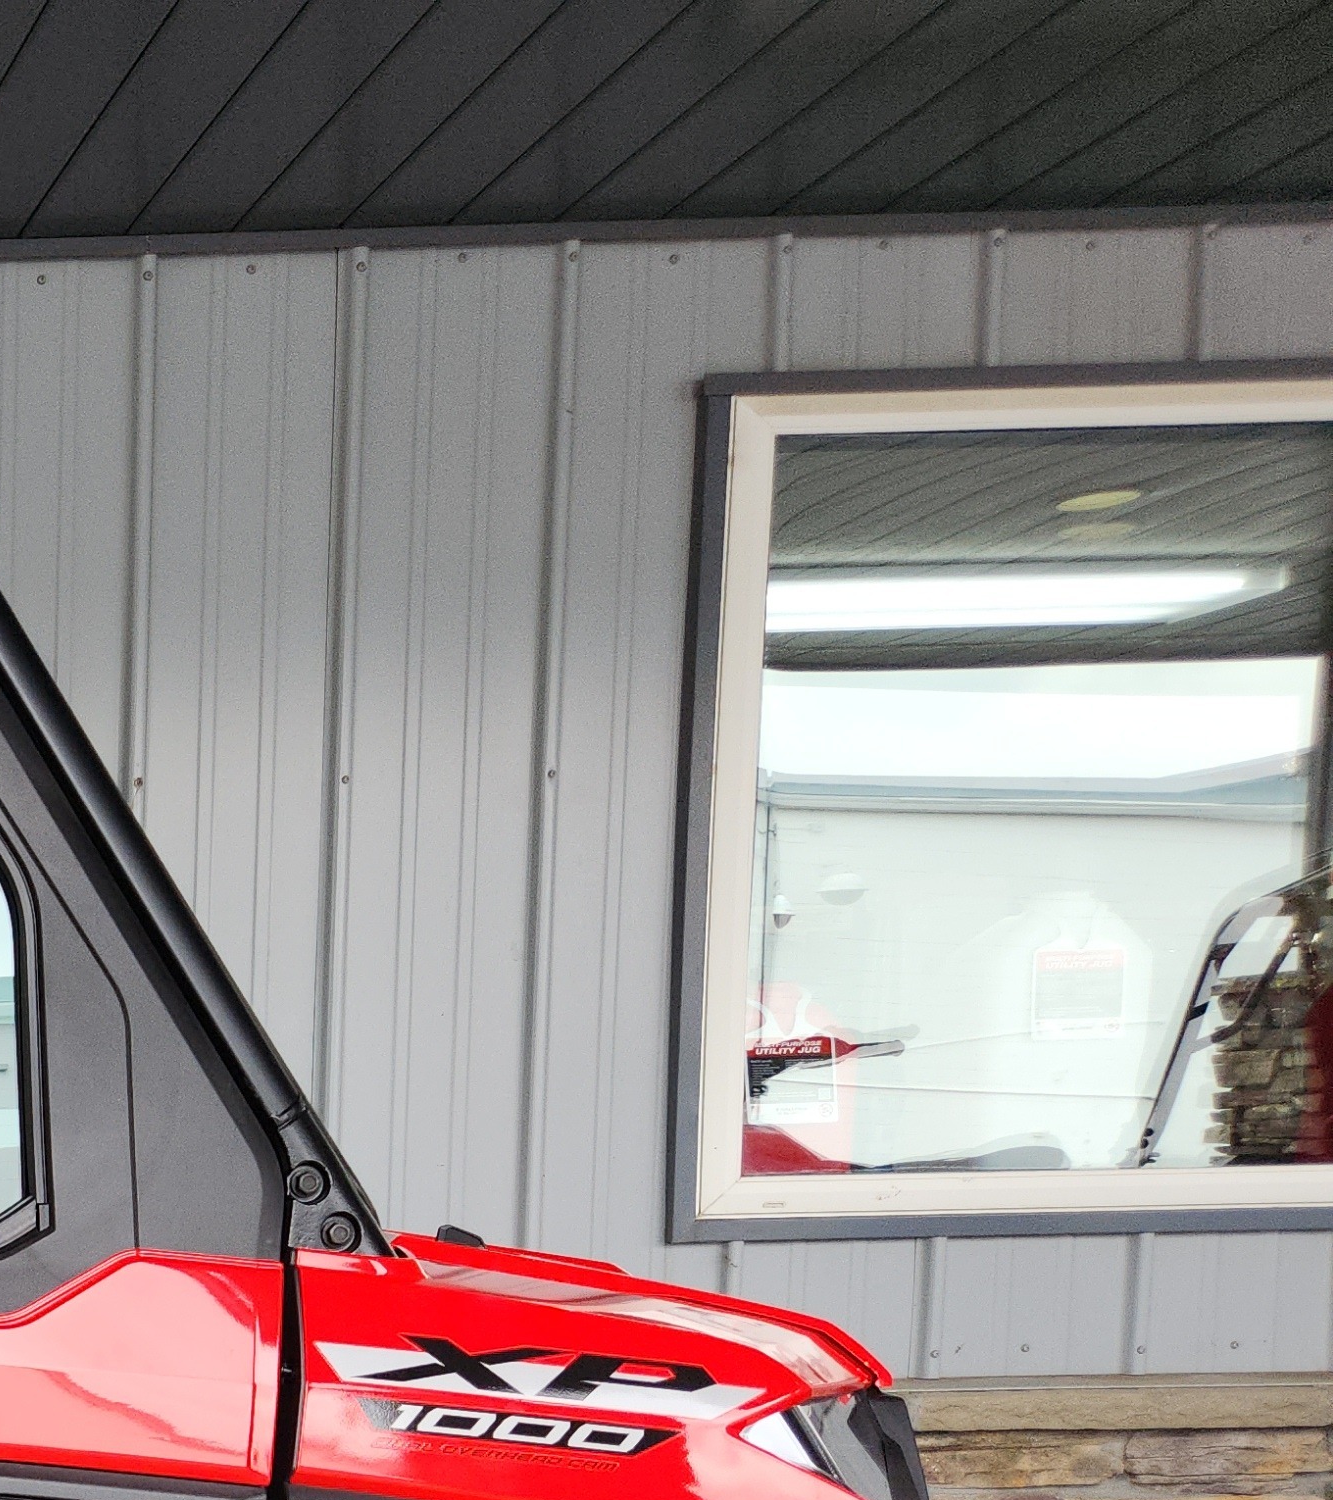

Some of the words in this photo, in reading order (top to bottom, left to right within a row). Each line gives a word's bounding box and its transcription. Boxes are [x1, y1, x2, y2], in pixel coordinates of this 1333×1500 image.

[755, 1046, 796, 1055] UTILITY
[797, 1046, 821, 1054] JUG
[353, 1333, 718, 1400] XP
[390, 1404, 645, 1453] 1000
